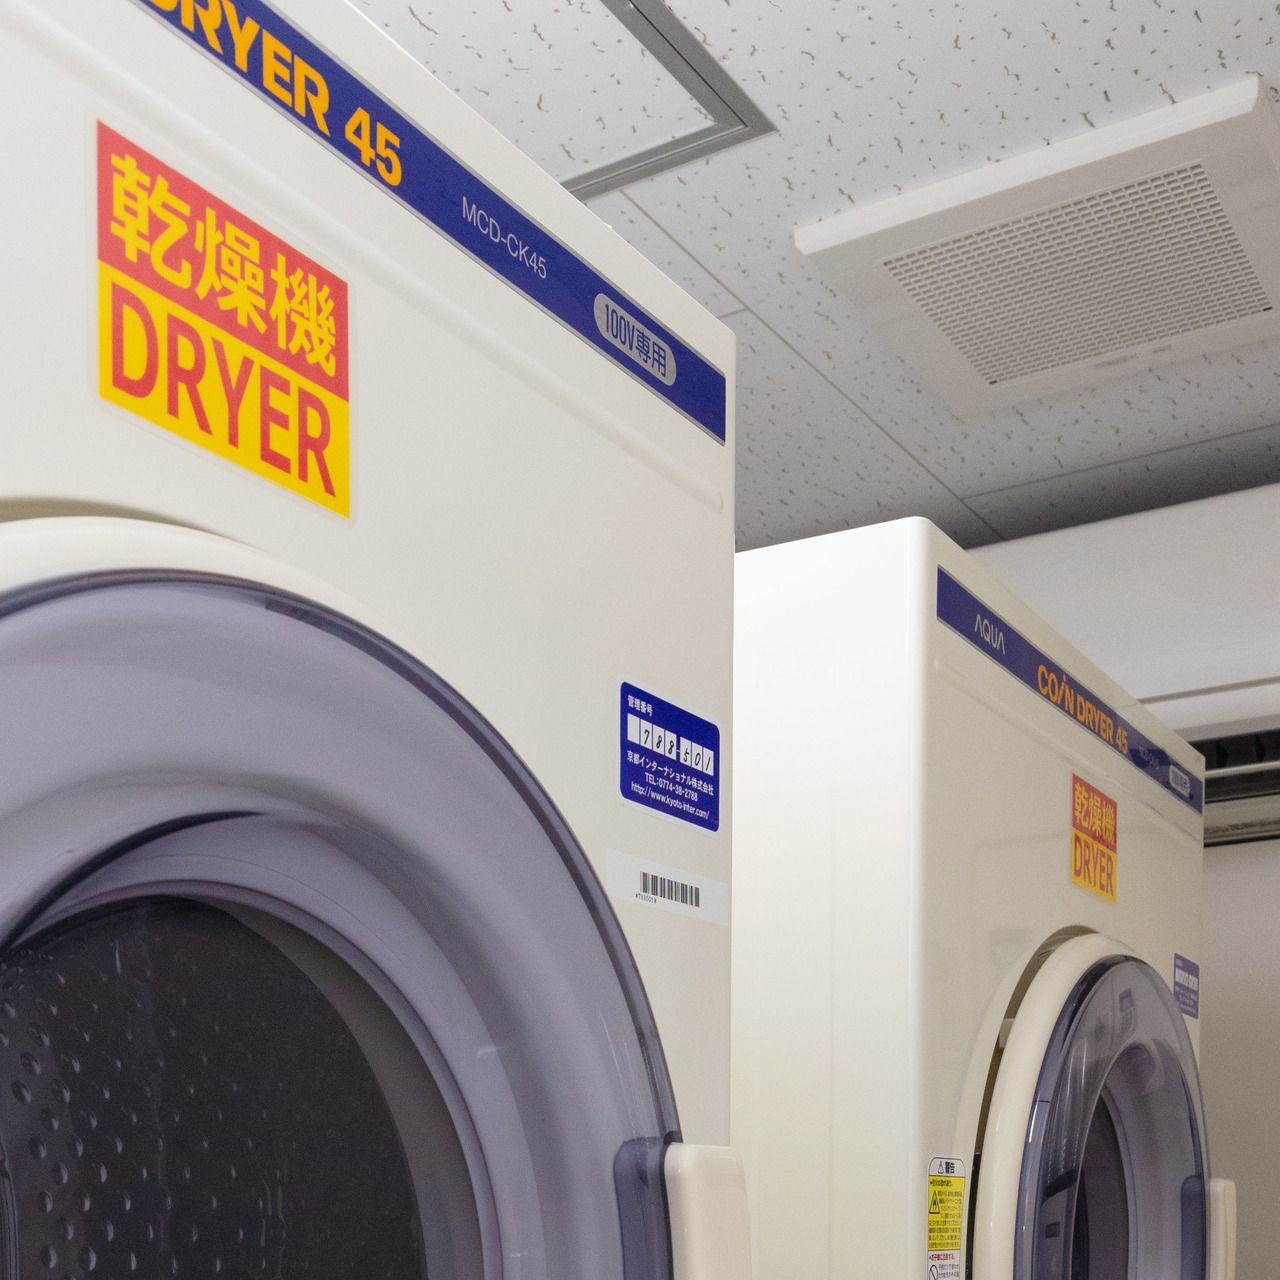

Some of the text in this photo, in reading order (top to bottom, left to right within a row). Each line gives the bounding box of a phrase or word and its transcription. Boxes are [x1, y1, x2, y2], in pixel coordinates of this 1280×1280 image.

[147, 0, 402, 186] RYER 45
[109, 153, 337, 378] 乾燥機
[461, 195, 548, 280] MCD-CK45
[603, 302, 668, 378] 100V専用
[111, 281, 337, 499] DRYER
[627, 694, 653, 717] 管理番号
[1076, 693, 1114, 743] DRYER
[1114, 727, 1129, 755] 45
[626, 750, 714, 797] 京都インターナショナル株式会社
[1073, 780, 1116, 847] 乾燥機
[1074, 832, 1115, 897] DRYER
